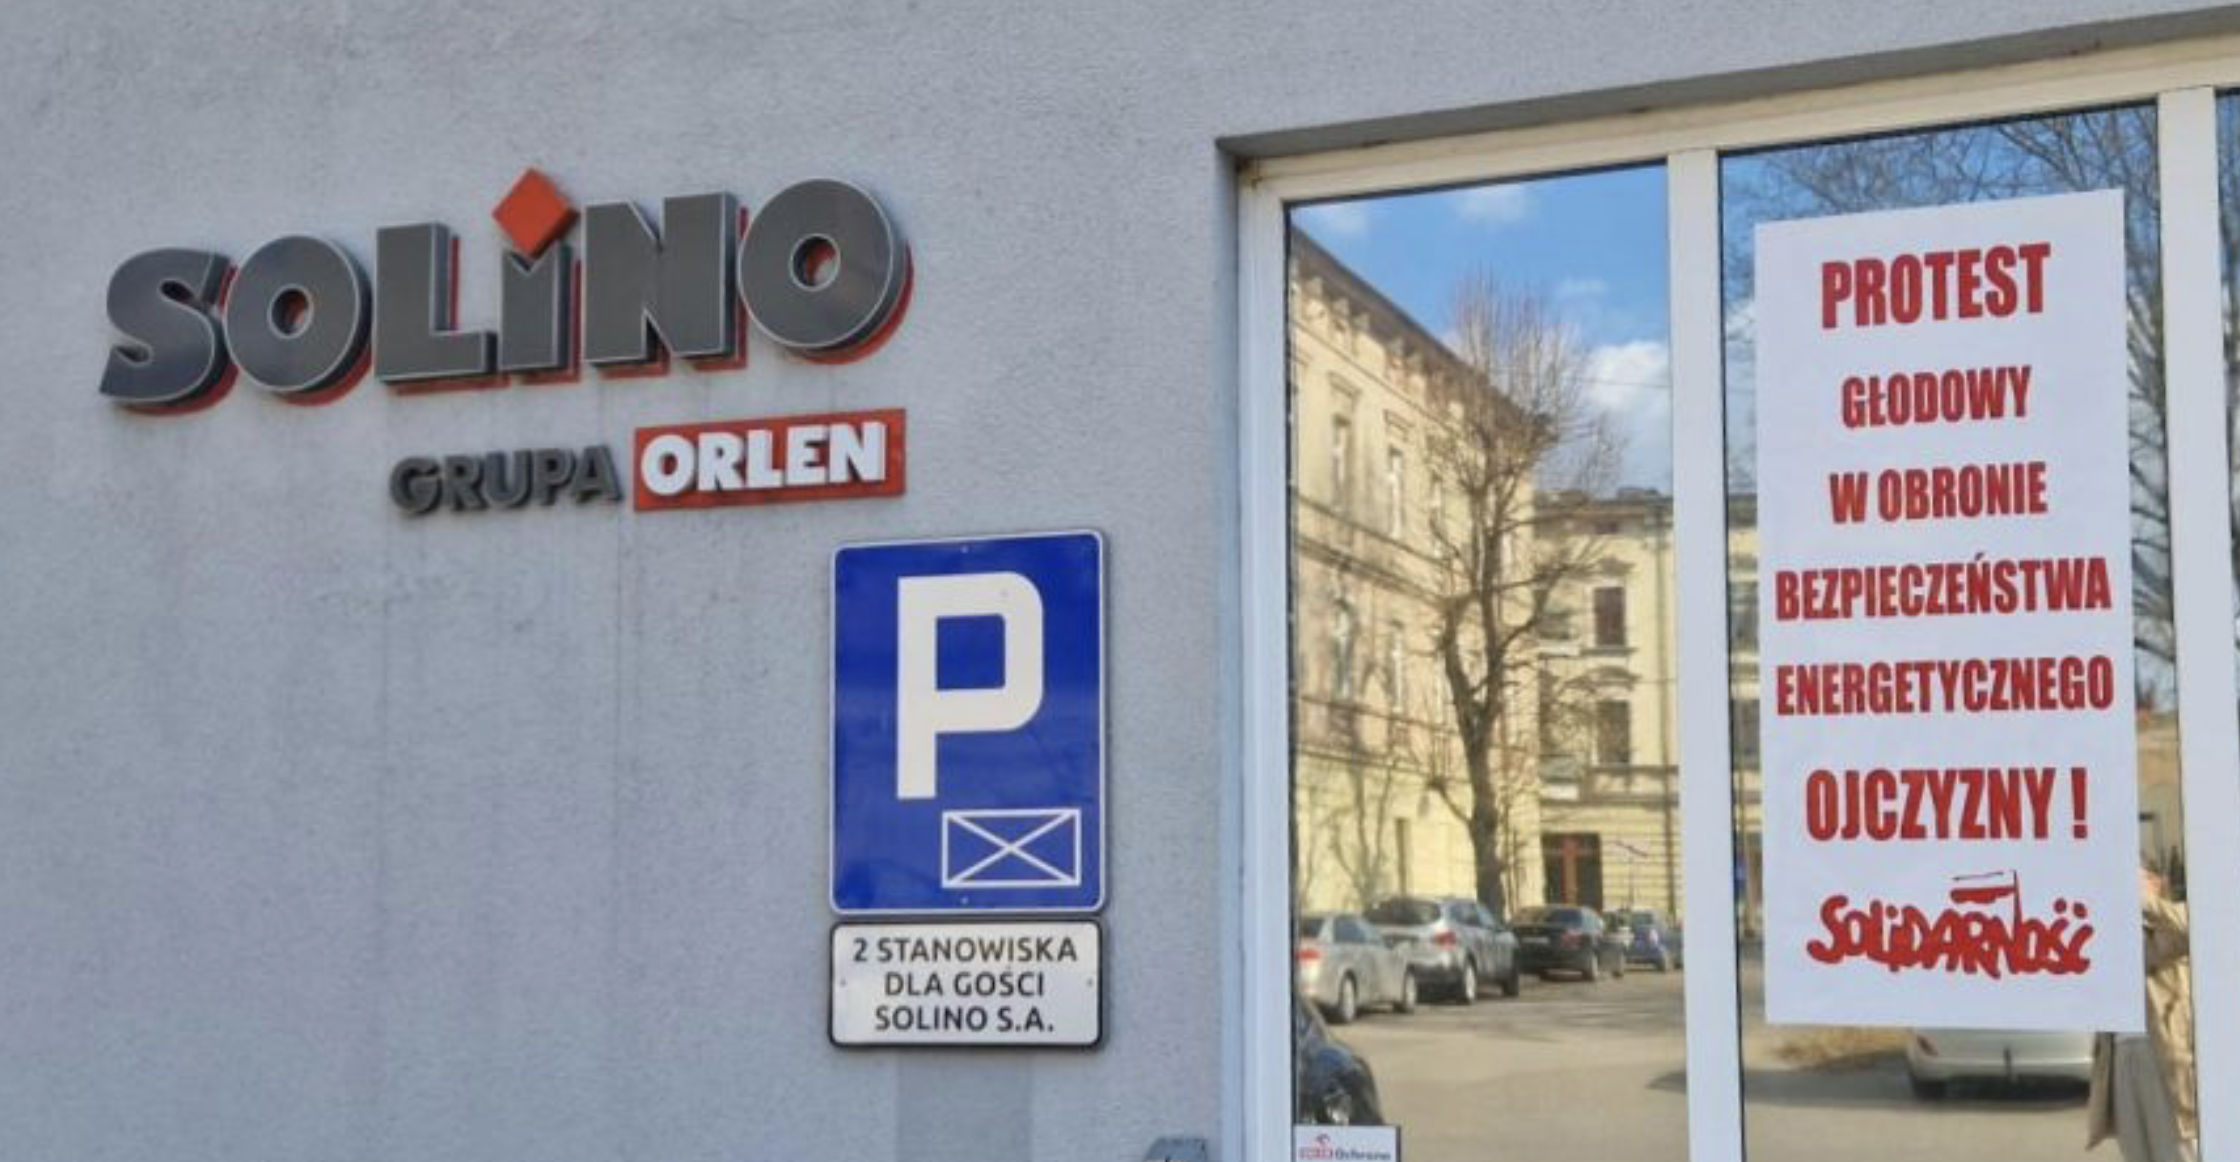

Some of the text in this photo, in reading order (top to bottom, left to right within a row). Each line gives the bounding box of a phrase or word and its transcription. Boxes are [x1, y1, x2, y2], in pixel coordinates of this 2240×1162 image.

[1821, 241, 2051, 329] PROTEST
[1841, 365, 2031, 429] GŁODOWY
[390, 421, 886, 516] GRUPA ORLEN
[1829, 461, 2048, 524] W OBRONIE
[1775, 553, 2113, 621] BEZPIECZEŃSTWA
[897, 571, 1044, 800] P
[1775, 655, 2114, 717] ENERGETYCZNEGO
[1805, 767, 2056, 841] OJCZYZNY
[853, 937, 1077, 962] 2 STANOWISKA
[885, 967, 1044, 997] DLA GOŚCI
[875, 1005, 1055, 1032] SOLINO S.A.
